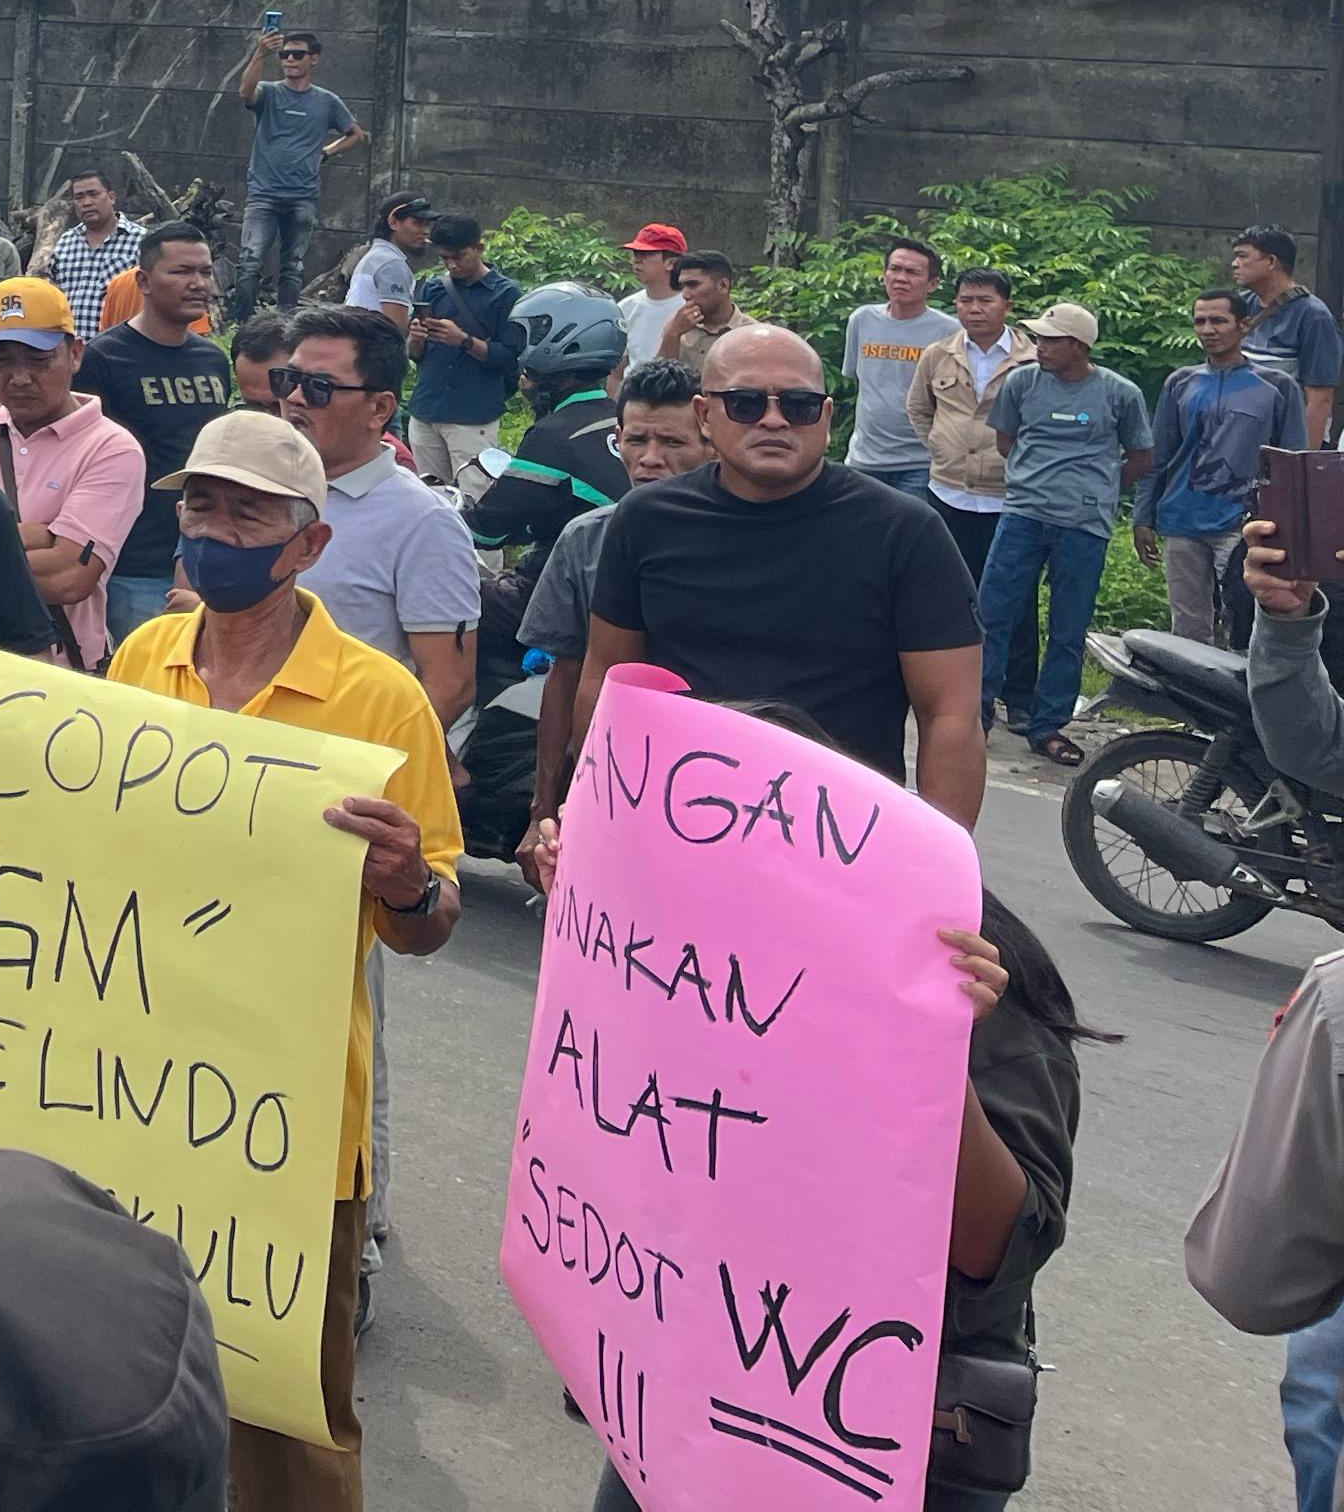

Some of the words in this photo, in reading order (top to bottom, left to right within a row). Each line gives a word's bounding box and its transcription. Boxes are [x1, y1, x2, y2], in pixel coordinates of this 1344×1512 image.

[140, 375, 226, 405] EIGER
[548, 1009, 769, 1181] ALAT
[719, 1260, 925, 1451] WC
